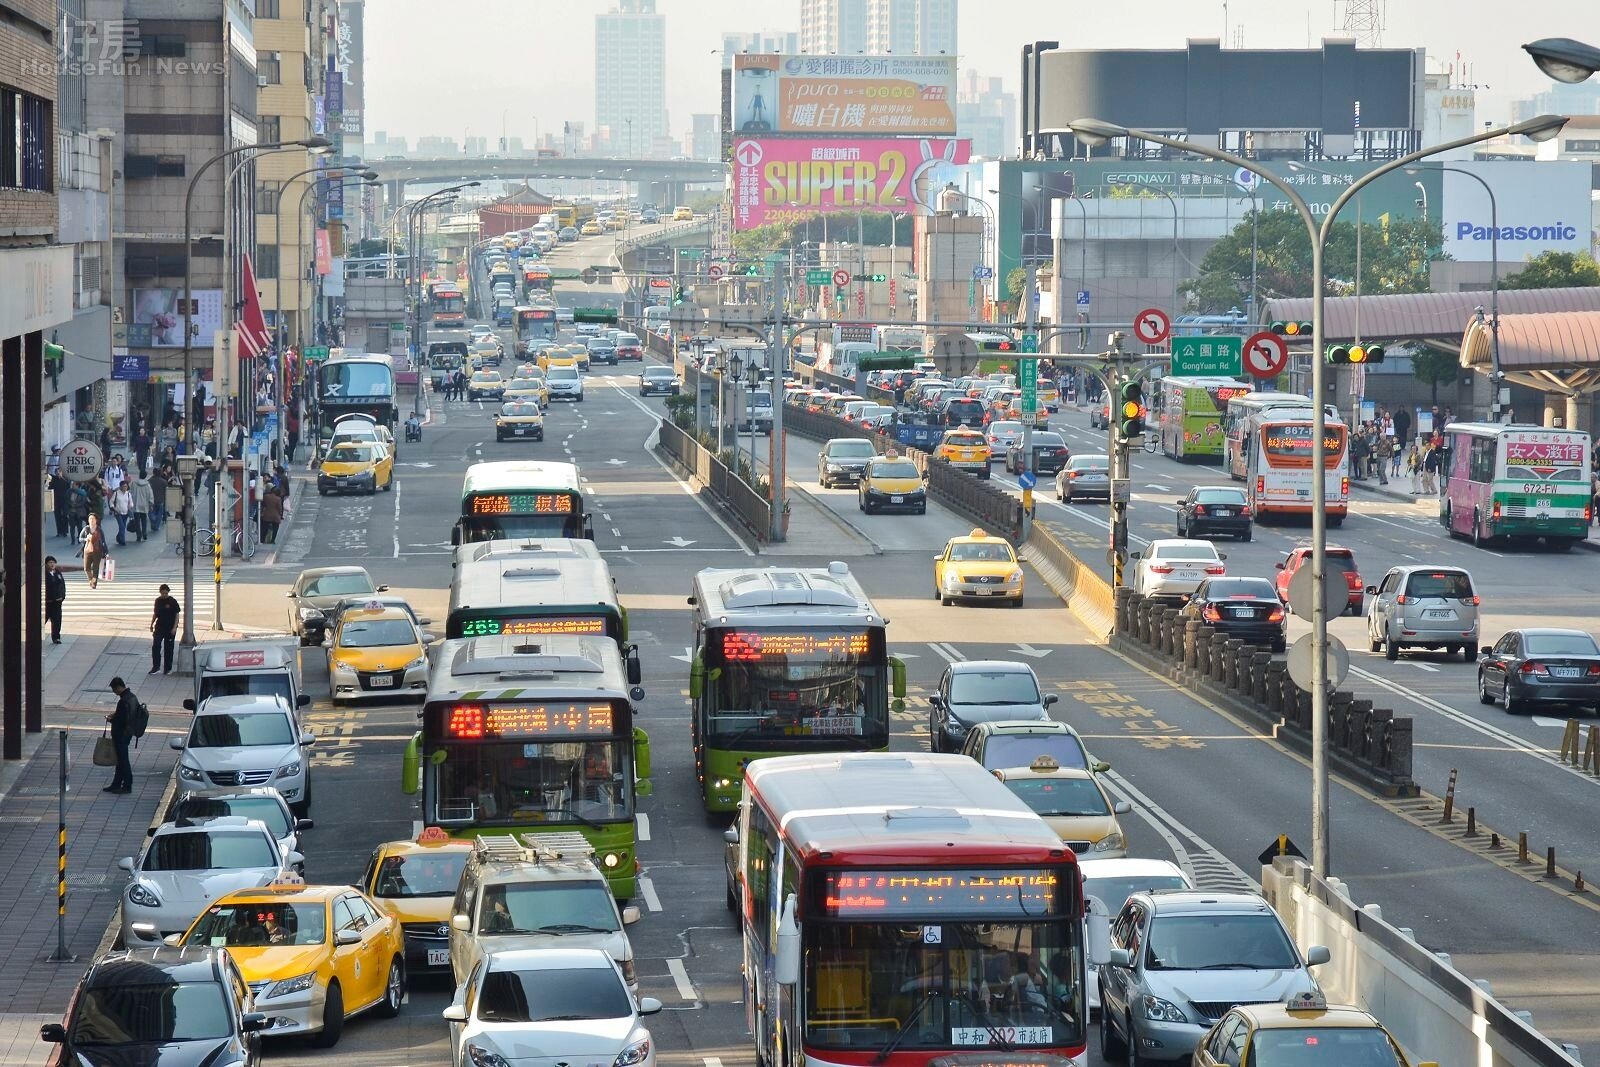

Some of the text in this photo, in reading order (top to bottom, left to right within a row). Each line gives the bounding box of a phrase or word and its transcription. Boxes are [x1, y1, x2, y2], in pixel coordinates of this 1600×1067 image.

[806, 58, 889, 76] 愛爾麗診所
[796, 82, 839, 99] pura
[811, 147, 861, 160] 超級城市
[1106, 174, 1172, 184] ECONAVI
[1457, 221, 1576, 241] Panasonic
[1182, 343, 1230, 357] 公園路
[1182, 361, 1217, 370] GongYuan
[1508, 444, 1582, 460] 女人徵信
[66, 456, 96, 466] HSBC
[1523, 483, 1558, 494] 672-FW
[428, 951, 450, 964] TAC-
[957, 1031, 985, 1045] 中和
[1017, 1030, 1051, 1045] 市政府
